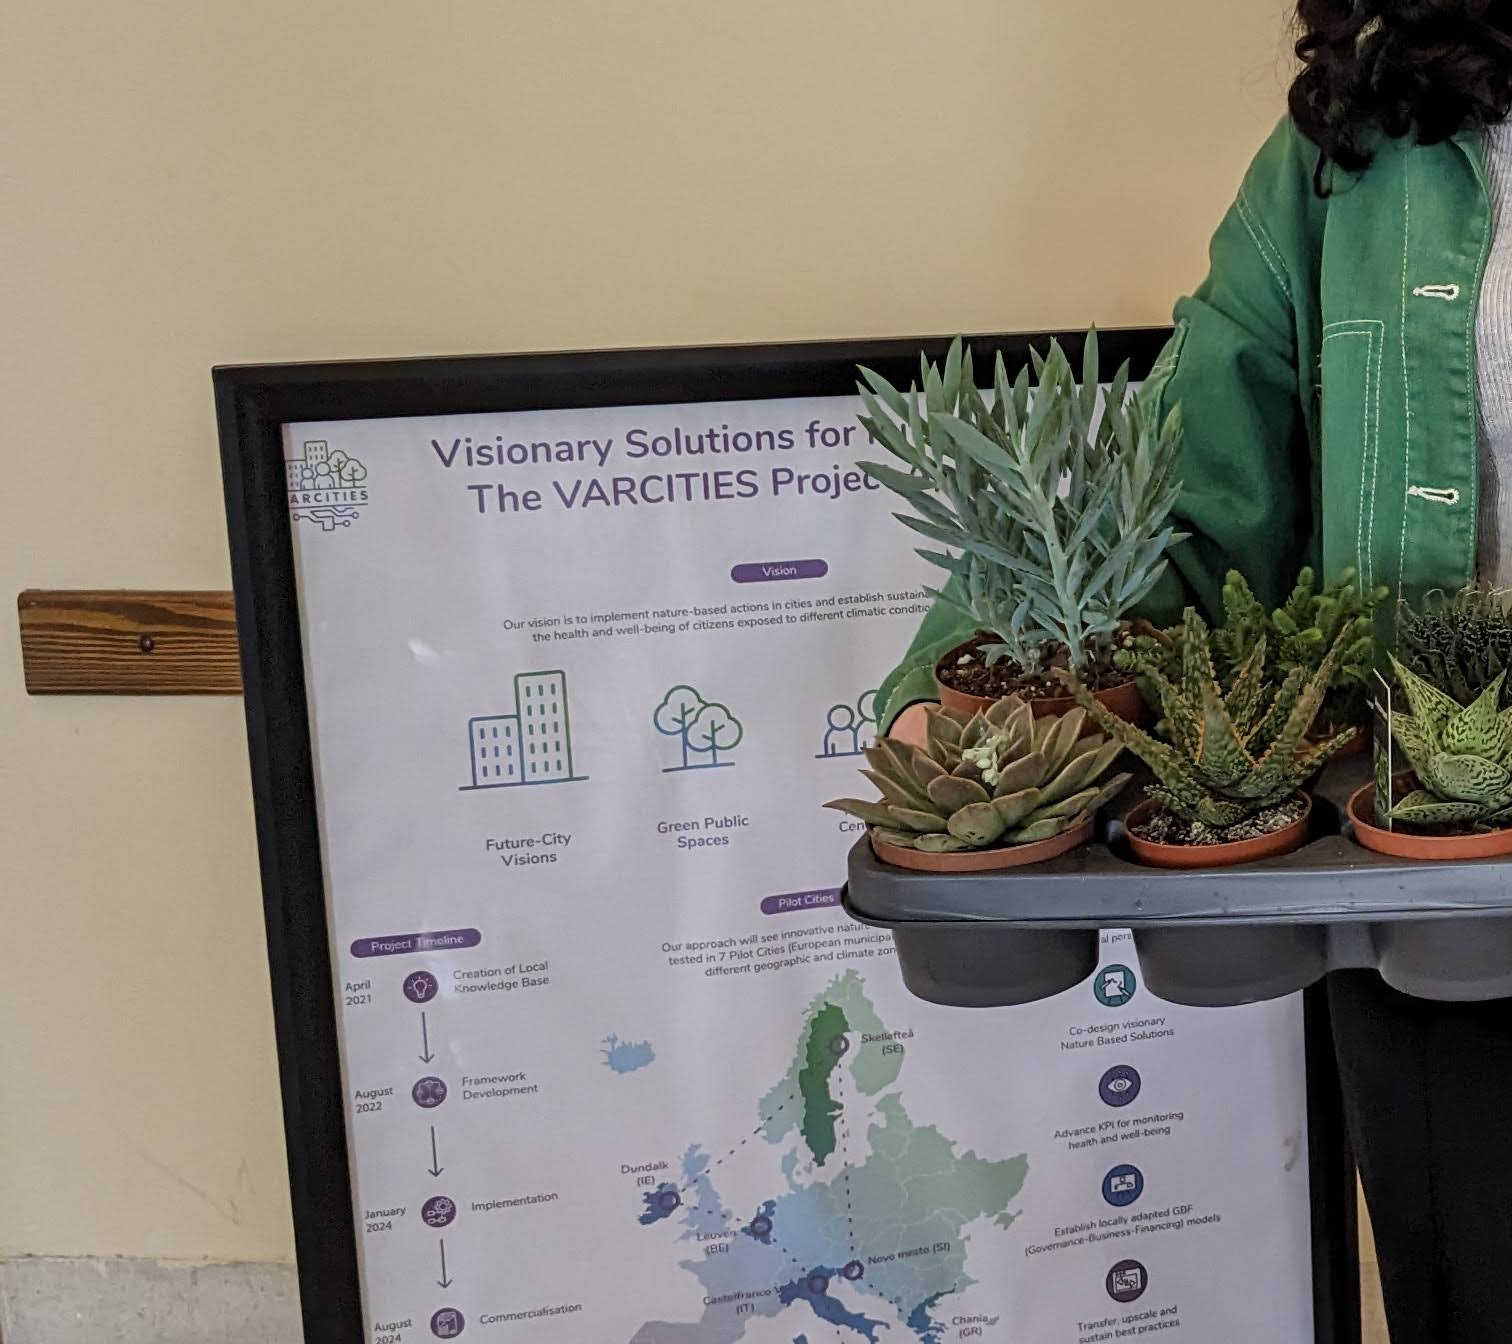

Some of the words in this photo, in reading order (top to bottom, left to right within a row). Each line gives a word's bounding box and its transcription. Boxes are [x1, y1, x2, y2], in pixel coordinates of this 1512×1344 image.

[431, 436, 613, 468] Visionary
[625, 424, 795, 458] Solutions
[805, 420, 856, 448] for
[467, 483, 542, 513] The
[552, 469, 759, 508] VARCITIES
[772, 464, 881, 500] Projec
[290, 490, 368, 504] ARCITIES
[762, 565, 798, 578] Vision
[503, 618, 525, 630] Our
[529, 615, 560, 628] vision
[564, 614, 574, 625] is
[576, 613, 588, 624] to
[591, 608, 650, 625] implement
[652, 602, 728, 619] nature-based
[730, 600, 770, 613] actions
[772, 599, 782, 610] in
[785, 597, 812, 609] cities
[816, 594, 836, 607] and
[838, 591, 884, 605] establish
[533, 630, 550, 642] the
[554, 627, 590, 640] health
[592, 625, 614, 637] and
[616, 621, 676, 635] well-being
[679, 619, 690, 631] of
[693, 617, 734, 630] citizens
[737, 612, 784, 628] exposed
[785, 612, 798, 623] to
[800, 608, 844, 622] different
[846, 605, 886, 618] climatic
[657, 819, 700, 834] Green
[704, 814, 750, 830] Public
[486, 832, 572, 851] Future-City
[677, 833, 730, 850] Spaces
[501, 851, 558, 867] Visions
[778, 896, 802, 909] Pilot
[804, 893, 835, 906] Cities
[371, 940, 412, 953] Project
[416, 933, 464, 948] Timeline
[705, 961, 750, 976] different
[754, 955, 810, 973] geographic
[814, 952, 834, 964] and
[836, 947, 874, 961] climate
[877, 947, 896, 956] zon
[453, 966, 501, 980] Creation
[505, 964, 516, 976] of
[519, 960, 549, 973] Local
[345, 980, 371, 994] April
[454, 979, 519, 994] Knowledge
[522, 976, 550, 988] Base
[346, 994, 372, 1006] 2021
[1069, 1022, 1120, 1037] Co-design
[1122, 1016, 1166, 1030] visionary
[1061, 1038, 1094, 1051] Nature
[1097, 1033, 1128, 1046] Based
[1130, 1027, 1175, 1042] Solutions
[882, 1044, 904, 1056] (SE)
[462, 1071, 527, 1087] Framework
[354, 1086, 394, 1101] August
[463, 1084, 539, 1101] Development
[356, 1101, 383, 1114] 2022
[1054, 1124, 1096, 1139] Advance
[1098, 1119, 1115, 1132] KPI
[1117, 1117, 1131, 1129] for
[1133, 1110, 1184, 1126] monitoring
[1068, 1137, 1098, 1150] health
[1100, 1133, 1118, 1144] and
[1120, 1125, 1171, 1141] well-being
[621, 1161, 669, 1174] Dundalk
[637, 1175, 656, 1187] (IE)
[472, 1191, 559, 1212] Implementation
[364, 1206, 407, 1220] January
[1186, 1213, 1221, 1226] models
[366, 1220, 392, 1233] 2024
[1054, 1220, 1096, 1237] Establish
[1098, 1215, 1128, 1230] locally
[1131, 1208, 1170, 1223] adapted
[696, 1230, 737, 1242] Leuven
[868, 1253, 896, 1265] Novo
[480, 1302, 583, 1325] Commercialisation
[736, 1303, 755, 1315] (IT)
[374, 1318, 412, 1333] August
[952, 1313, 988, 1326] Chania
[1077, 1316, 1120, 1332] Transfer,
[1122, 1309, 1158, 1325] upscale
[1160, 1305, 1178, 1317] and
[959, 1326, 983, 1339] (GR)
[1079, 1331, 1113, 1344] sustain
[1115, 1326, 1137, 1338] best
[1138, 1319, 1180, 1334] practices
